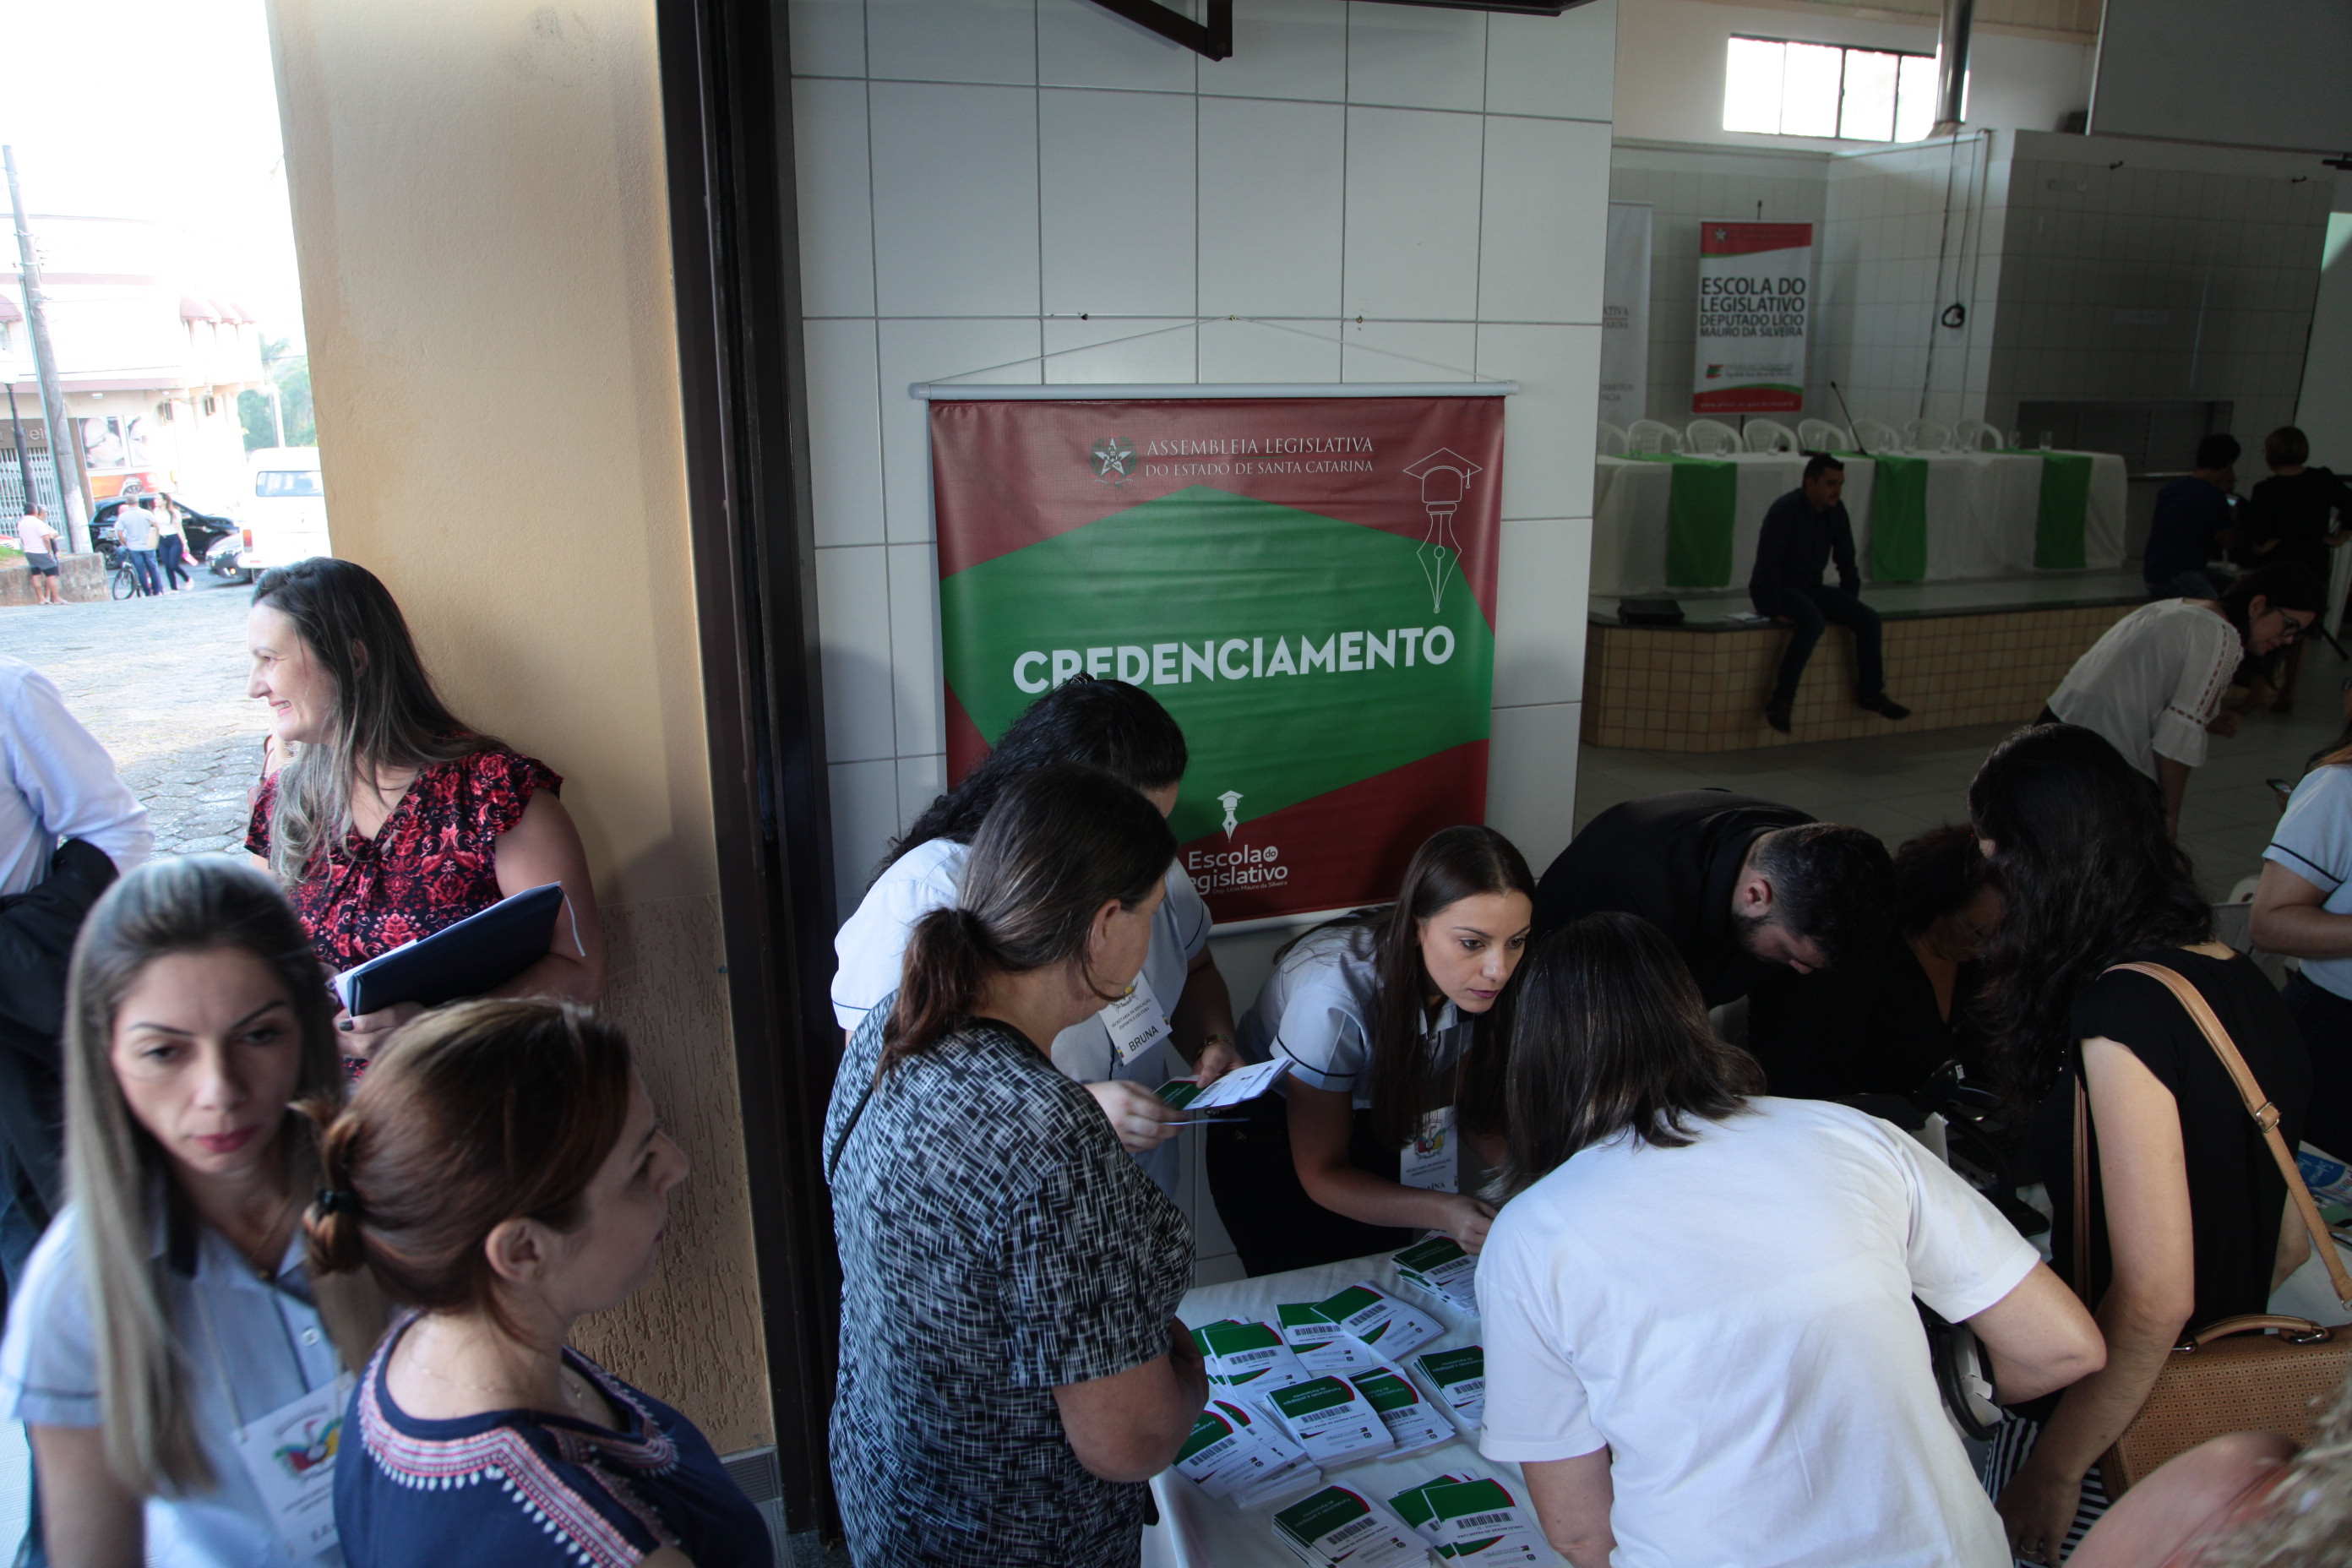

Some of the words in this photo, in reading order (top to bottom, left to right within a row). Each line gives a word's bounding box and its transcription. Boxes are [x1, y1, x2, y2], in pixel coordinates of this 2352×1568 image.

[1701, 277, 1772, 295] ESCOLA
[1778, 277, 1805, 295] DO
[1700, 297, 1805, 313] LEGISLATIVO
[1699, 313, 1769, 326] DEPUTADO
[1772, 312, 1804, 326] LÍCIO
[1699, 327, 1740, 337] MAURO
[1742, 327, 1756, 337] DA
[1759, 326, 1803, 337] SILVEIRA
[1146, 438, 1259, 455] ASSEMBLEIA
[1264, 436, 1374, 455] LEGISLATIVA
[1145, 463, 1169, 477] DO
[1173, 462, 1232, 476] ESTADO
[1235, 461, 1254, 475] DE
[1257, 460, 1301, 475] SANTA
[1305, 459, 1374, 474] CATARINA
[1013, 625, 1455, 694] CREDENCIAMENTO
[1188, 844, 1261, 870] Escola
[1265, 848, 1277, 858] do
[1190, 864, 1288, 896] egislativo
[1128, 1025, 1158, 1051] BRUNA
